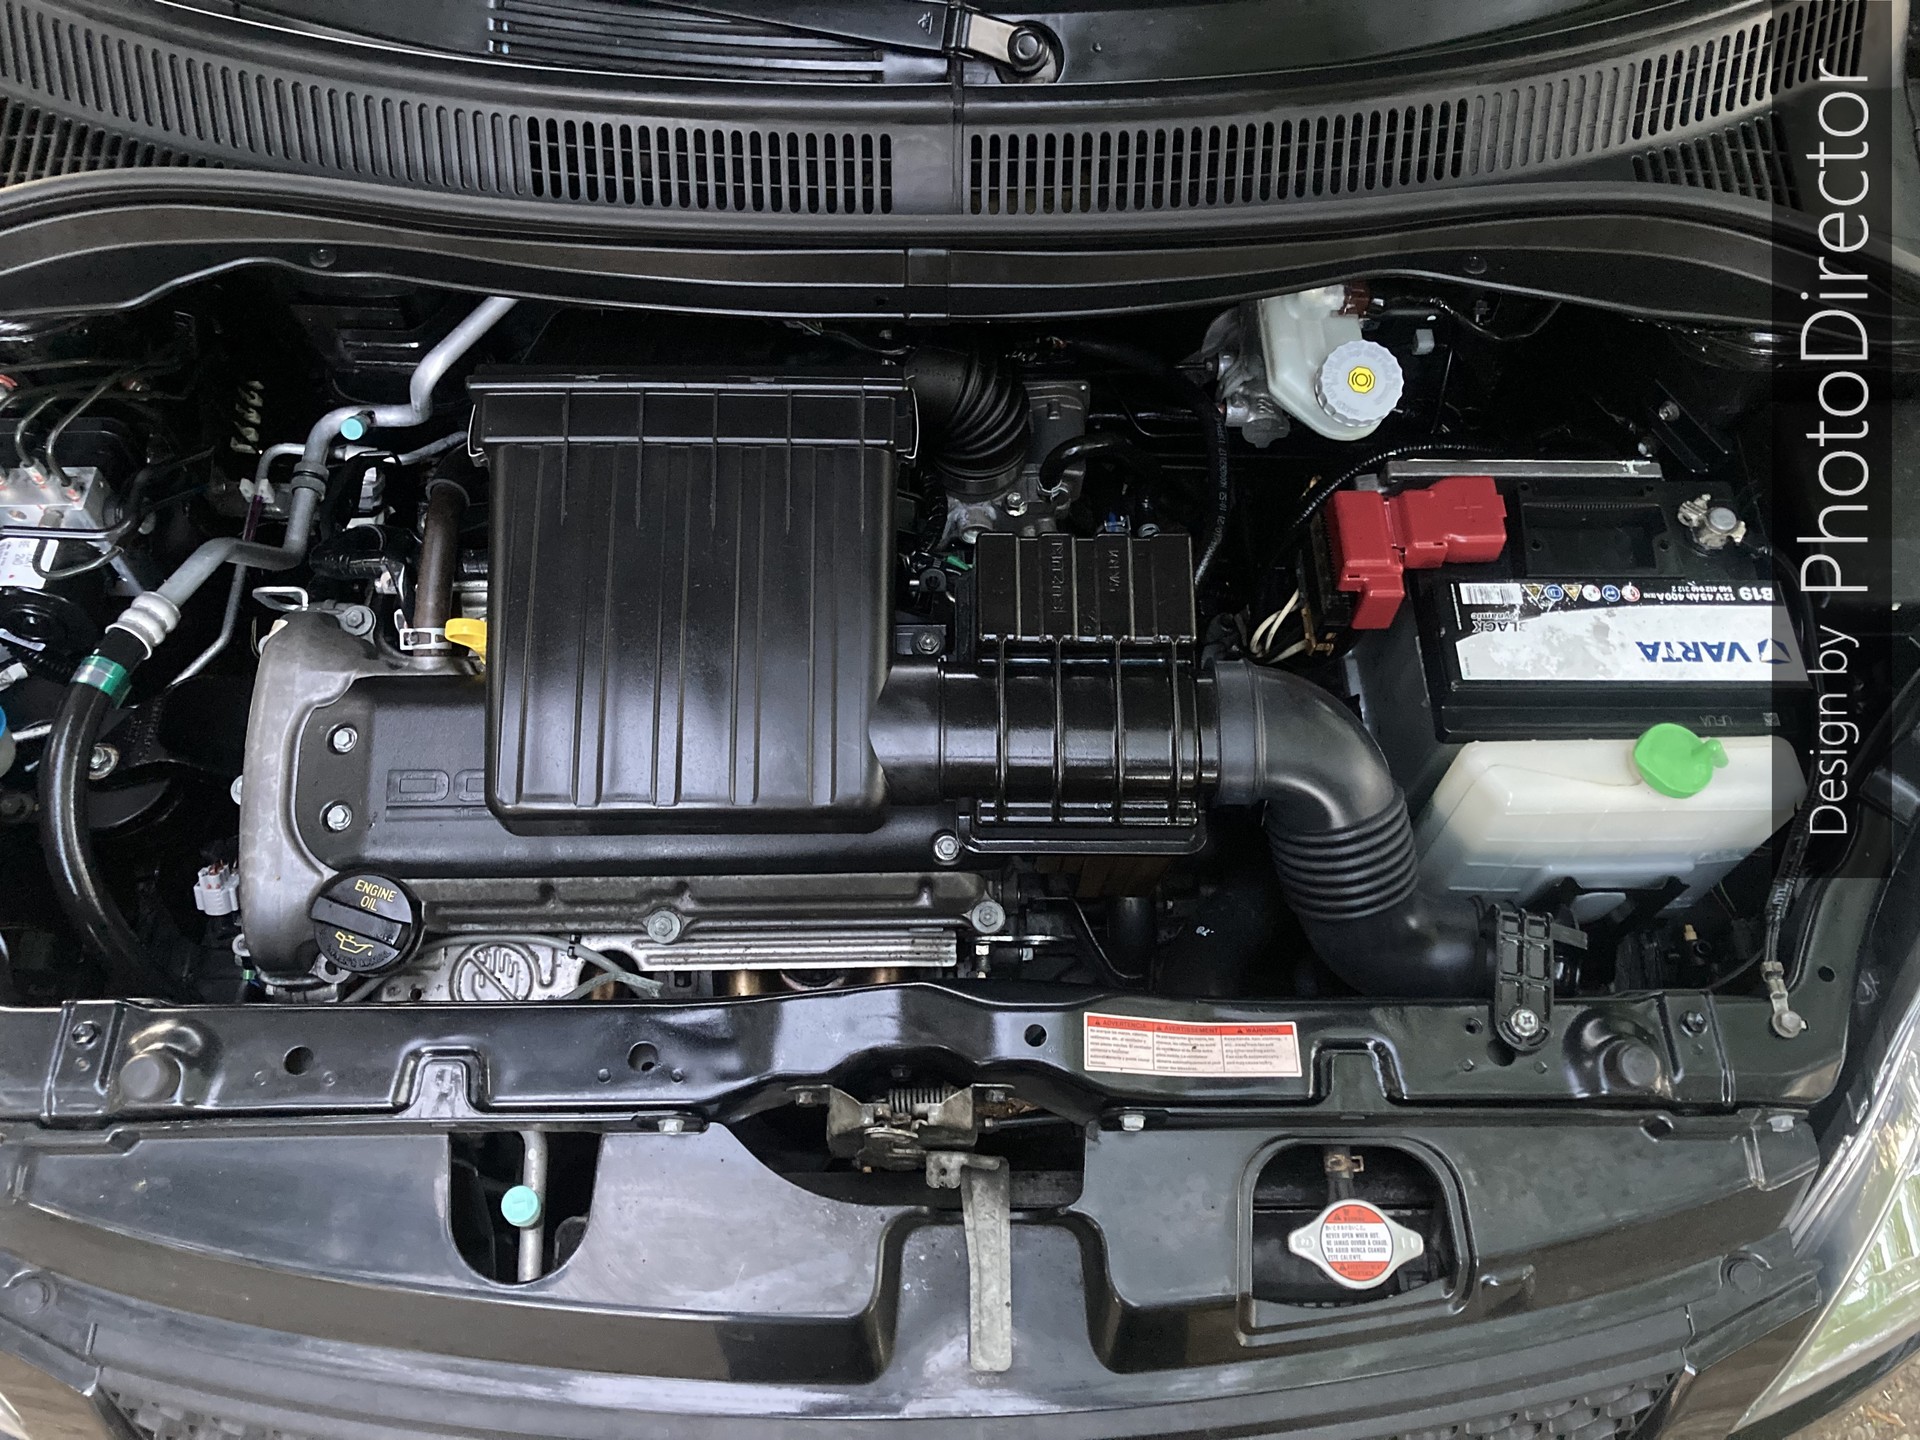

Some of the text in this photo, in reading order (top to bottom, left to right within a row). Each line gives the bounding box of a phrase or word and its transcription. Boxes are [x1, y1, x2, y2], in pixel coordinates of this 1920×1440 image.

[1714, 592, 1736, 602] 12V
[1738, 587, 1776, 601] B19
[1636, 641, 1753, 662] VARTA
[354, 879, 398, 903] ENGINE
[360, 896, 378, 911] OIL
[1102, 1019, 1146, 1028] ADVERTENCIA
